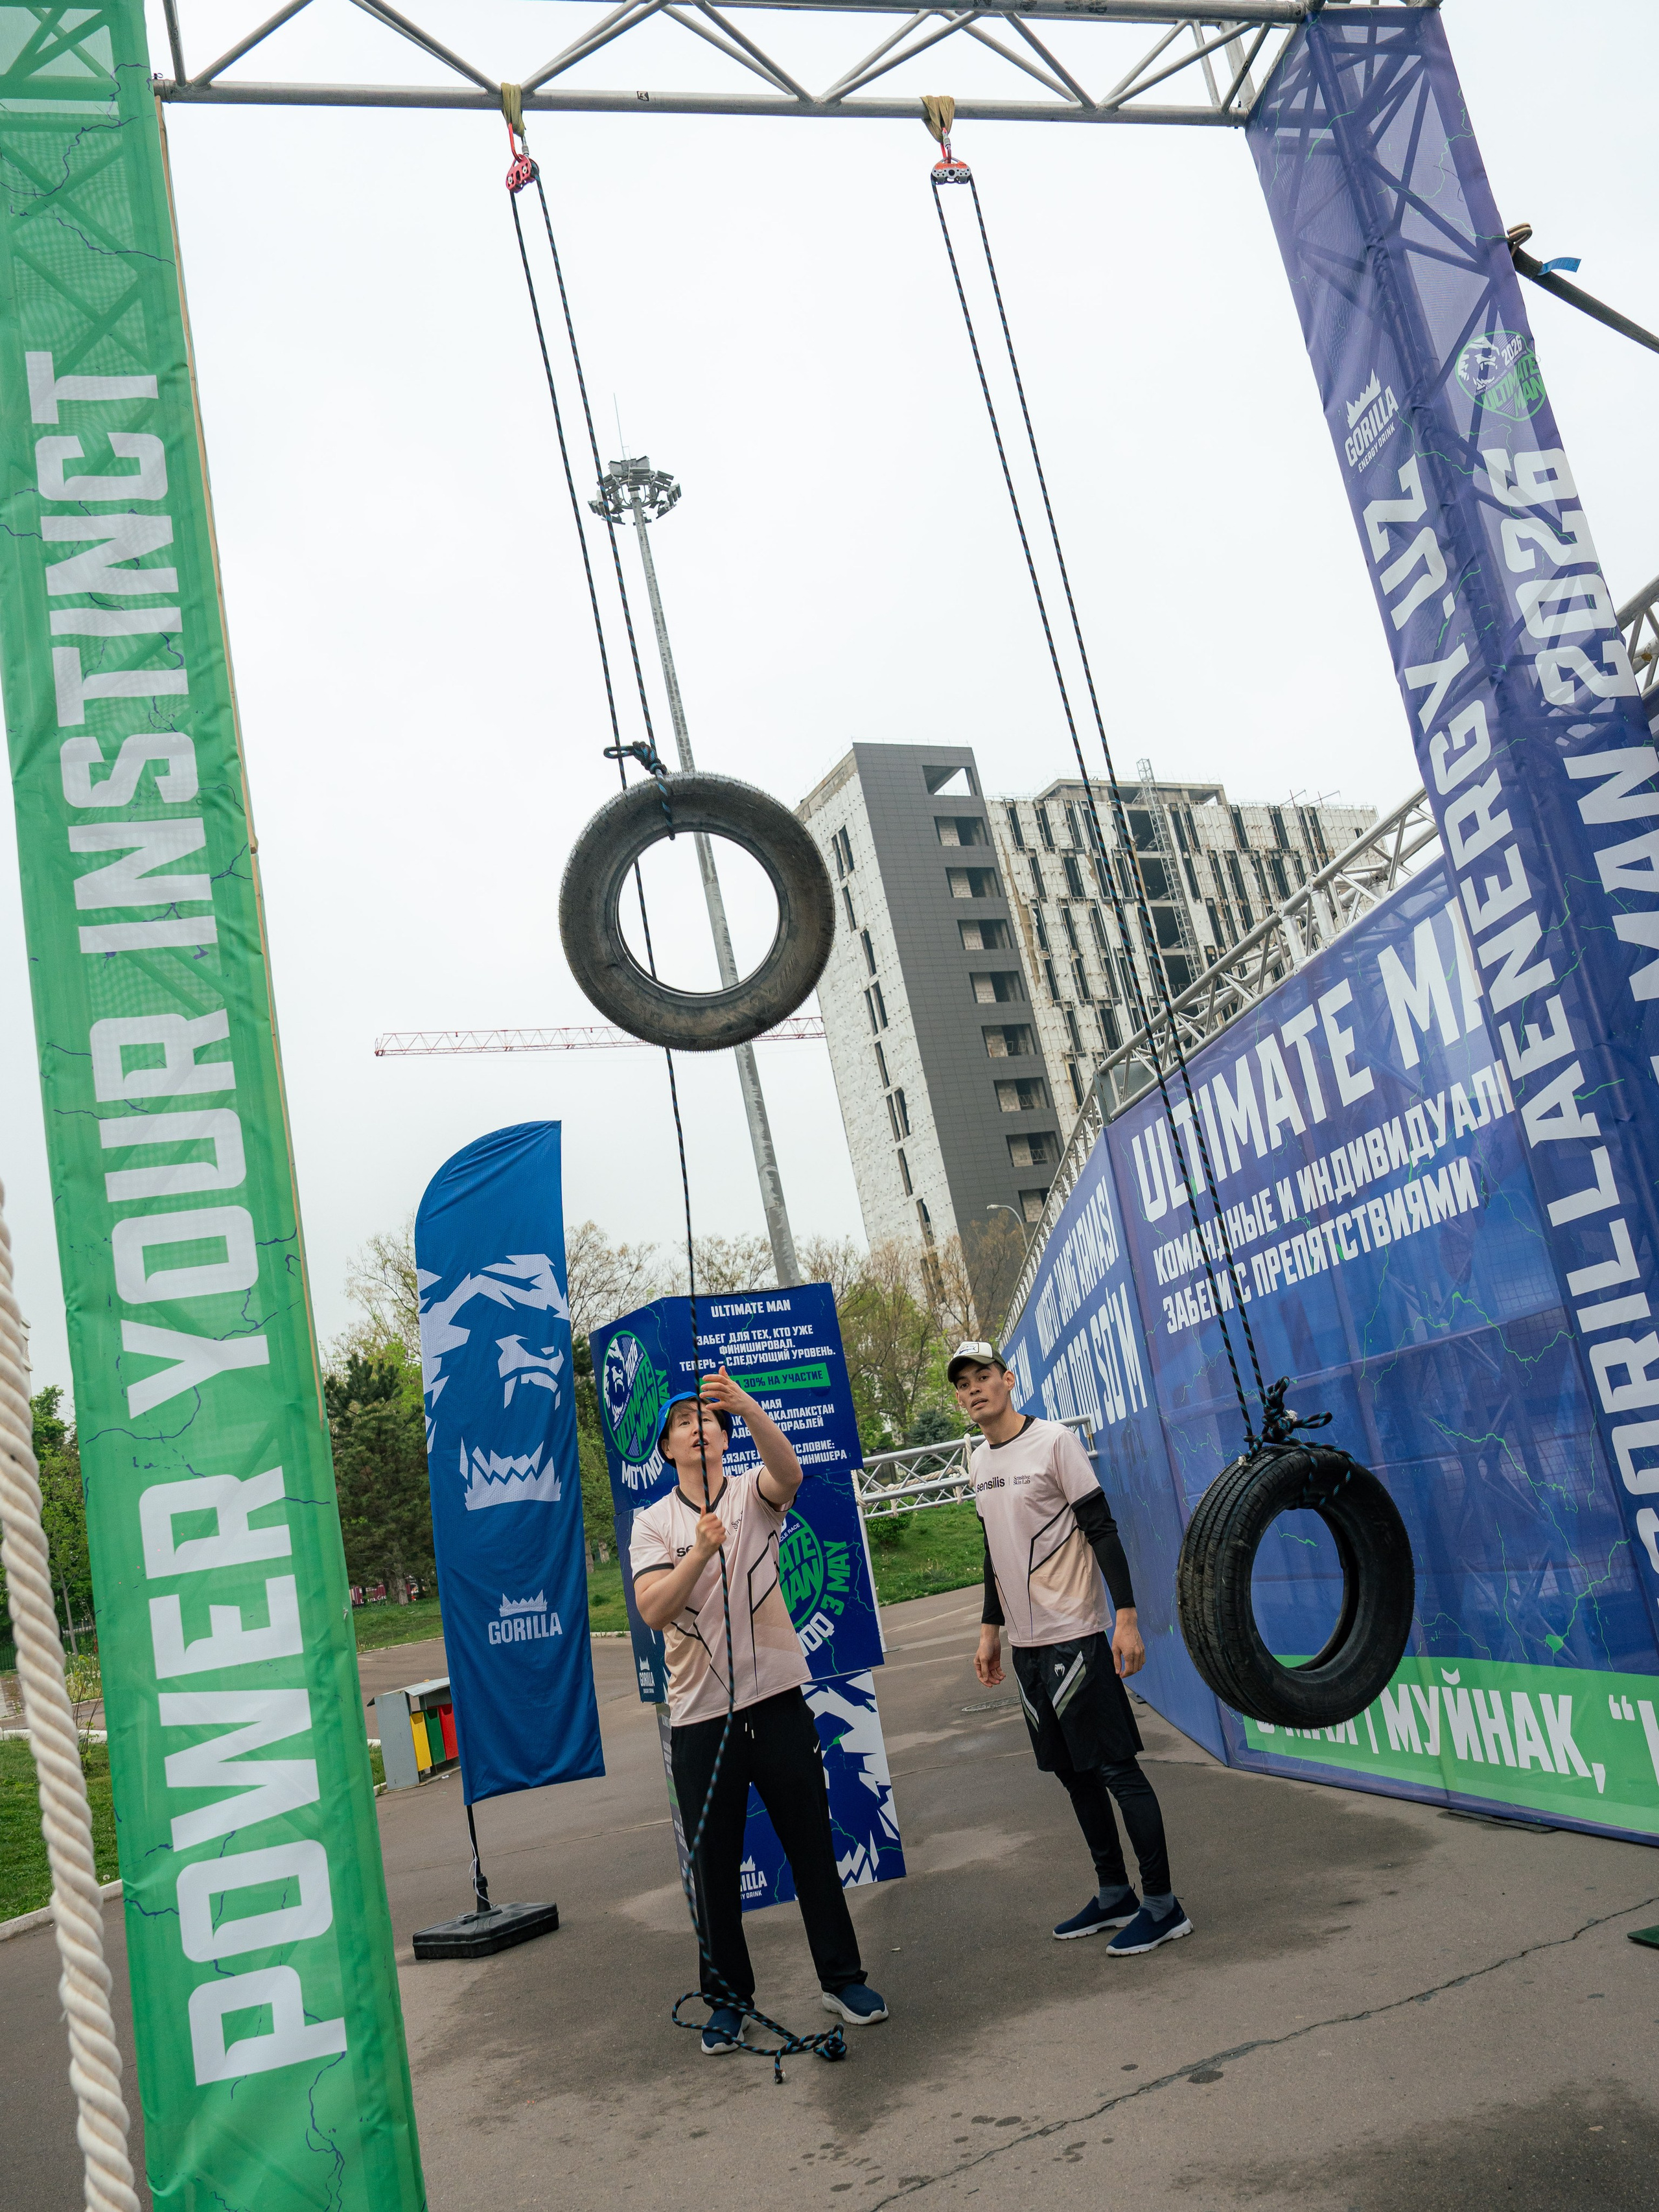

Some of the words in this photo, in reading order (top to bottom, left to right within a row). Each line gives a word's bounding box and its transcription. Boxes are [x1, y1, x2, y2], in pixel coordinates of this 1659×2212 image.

[1501, 334, 1522, 366] 2026
[1481, 353, 1540, 410] ULTIMATE
[1514, 375, 1546, 417] MAN
[1345, 385, 1399, 467] GORILLA
[1358, 442, 1378, 473] ENERGY
[1378, 422, 1395, 448] DRINK
[1482, 448, 1640, 705] 2026
[25, 351, 218, 953] INSTINCT
[1131, 978, 1375, 1222] ULTIMATE
[89, 1008, 270, 1420] YOUR
[1153, 1187, 1277, 1286] КОМАНДНЫЕ
[1276, 1176, 1297, 1223] И
[1233, 1262, 1252, 1304] С
[1252, 1156, 1479, 1297] ПРЕПЯТСТВИЯМИ
[711, 1301, 765, 1317] ULTIMATE
[767, 1299, 791, 1312] MAN
[696, 1333, 726, 1345] ЗАБЕГ
[728, 1331, 749, 1343] ДЛЯ
[751, 1329, 772, 1340] ТЕХ,
[773, 1327, 791, 1338] КТО
[793, 1325, 813, 1336] УЖЕ
[719, 1338, 796, 1355] ФИНИШИРОВАЛ.
[726, 1348, 790, 1366] СЛЕДУЮЩИЙ
[791, 1345, 836, 1360] УРОВЕНЬ.
[625, 1338, 638, 1387] 2026
[744, 1376, 765, 1388] 30%
[767, 1375, 780, 1386] НА
[783, 1370, 824, 1384] УЧАСТИЕ
[616, 1355, 654, 1454] ULTIMATE
[636, 1387, 658, 1456] MAN
[761, 1399, 782, 1410] МАЯ
[977, 1476, 1005, 1493] sensilis
[823, 1541, 851, 1592] MAY
[488, 1612, 563, 1645] GORILLA
[820, 1594, 845, 1616] 3
[1379, 1667, 1606, 1793] МУЙНАК,
[139, 1465, 348, 2086] POWER
[740, 1870, 767, 1892] ILLA
[746, 1890, 762, 1899] DRINK
